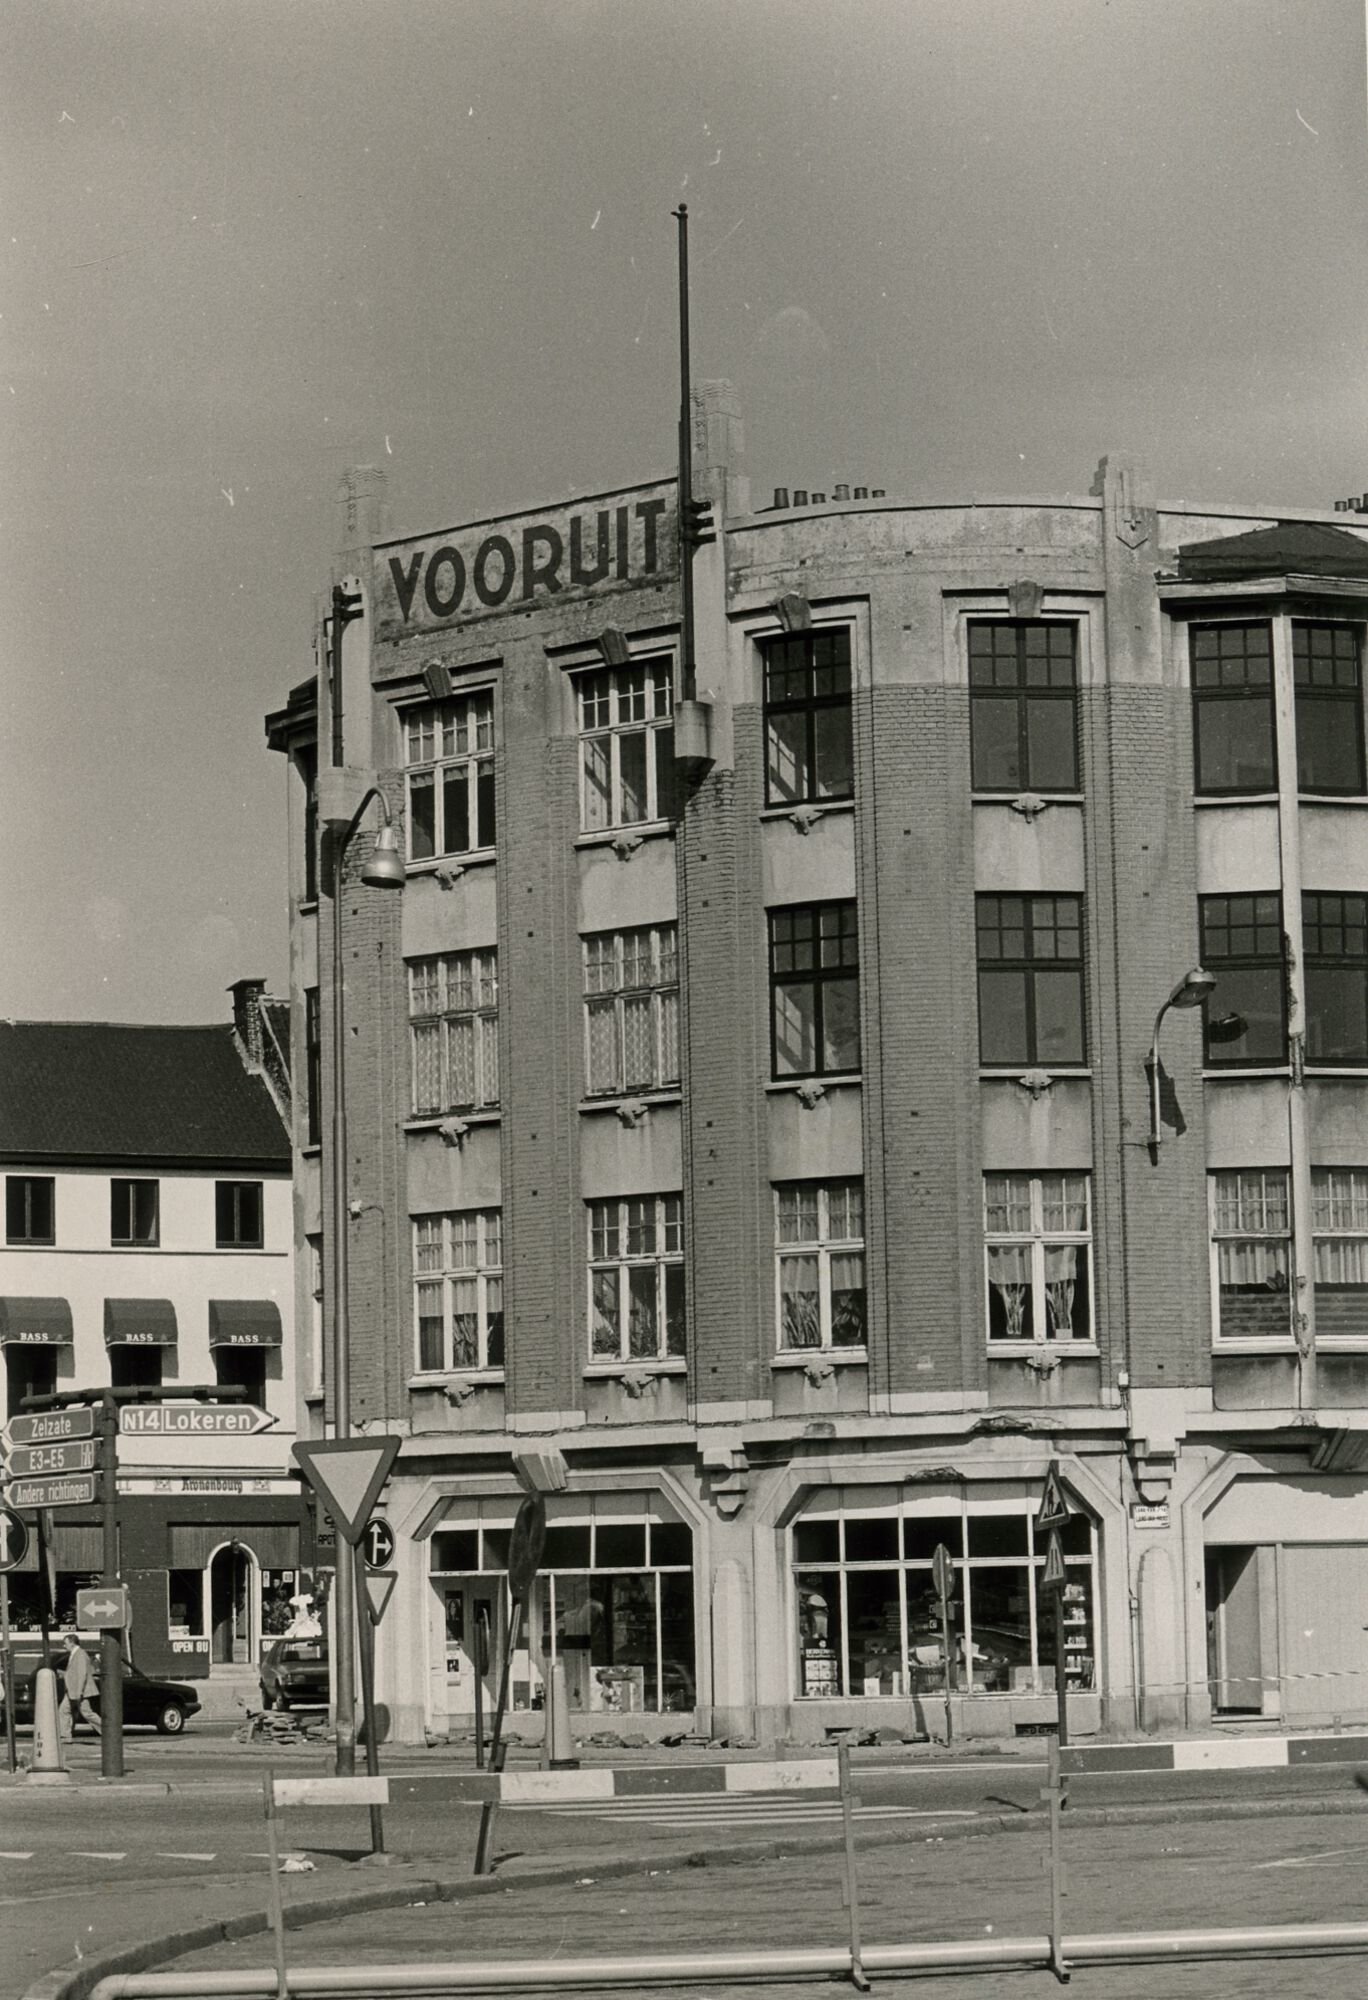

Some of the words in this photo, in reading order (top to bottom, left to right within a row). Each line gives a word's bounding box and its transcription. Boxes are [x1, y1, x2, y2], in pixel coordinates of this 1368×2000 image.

[388, 498, 666, 623] VOORUIT
[19, 1332, 49, 1342] BASS
[125, 1333, 154, 1342] BASS
[230, 1334, 260, 1344] BASS
[31, 1416, 72, 1438] Zelzate
[124, 1410, 160, 1431] N14
[164, 1410, 251, 1431] Lokeren
[29, 1448, 65, 1471] E3-E5
[16, 1484, 45, 1505] Andere
[48, 1480, 90, 1504] richtingen
[181, 1478, 244, 1494] Kronenbourg
[172, 1640, 194, 1653] OPEN
